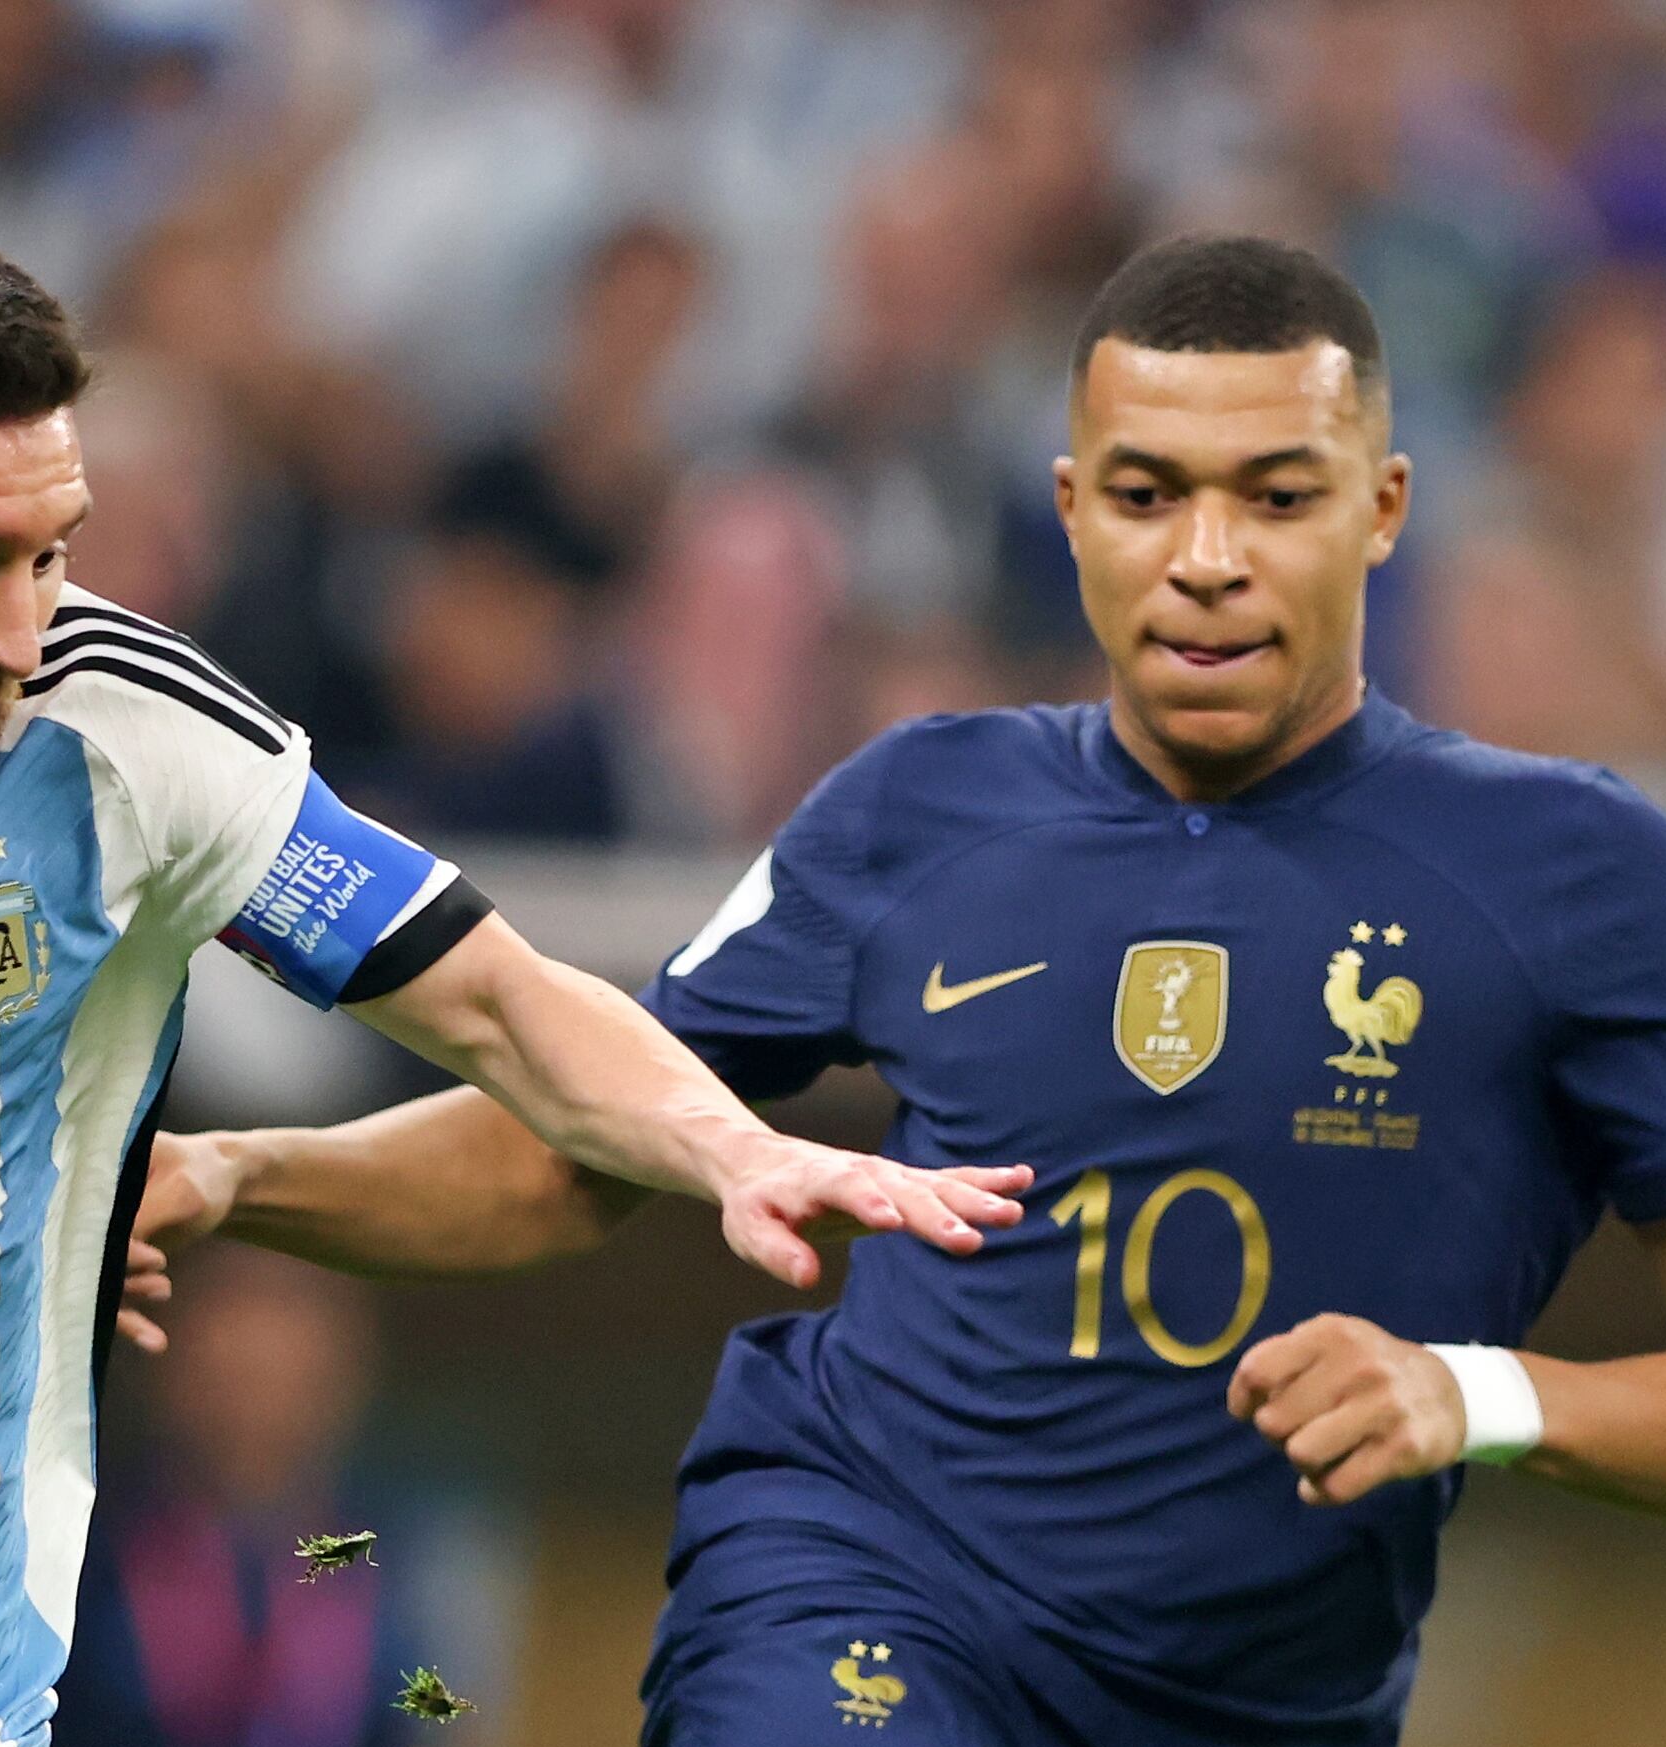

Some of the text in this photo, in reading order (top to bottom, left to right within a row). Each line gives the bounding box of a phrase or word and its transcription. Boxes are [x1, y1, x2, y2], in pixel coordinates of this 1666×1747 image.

[257, 845, 345, 938] UNITES
[292, 860, 377, 954] the World
[1047, 1164, 1272, 1368] 10
